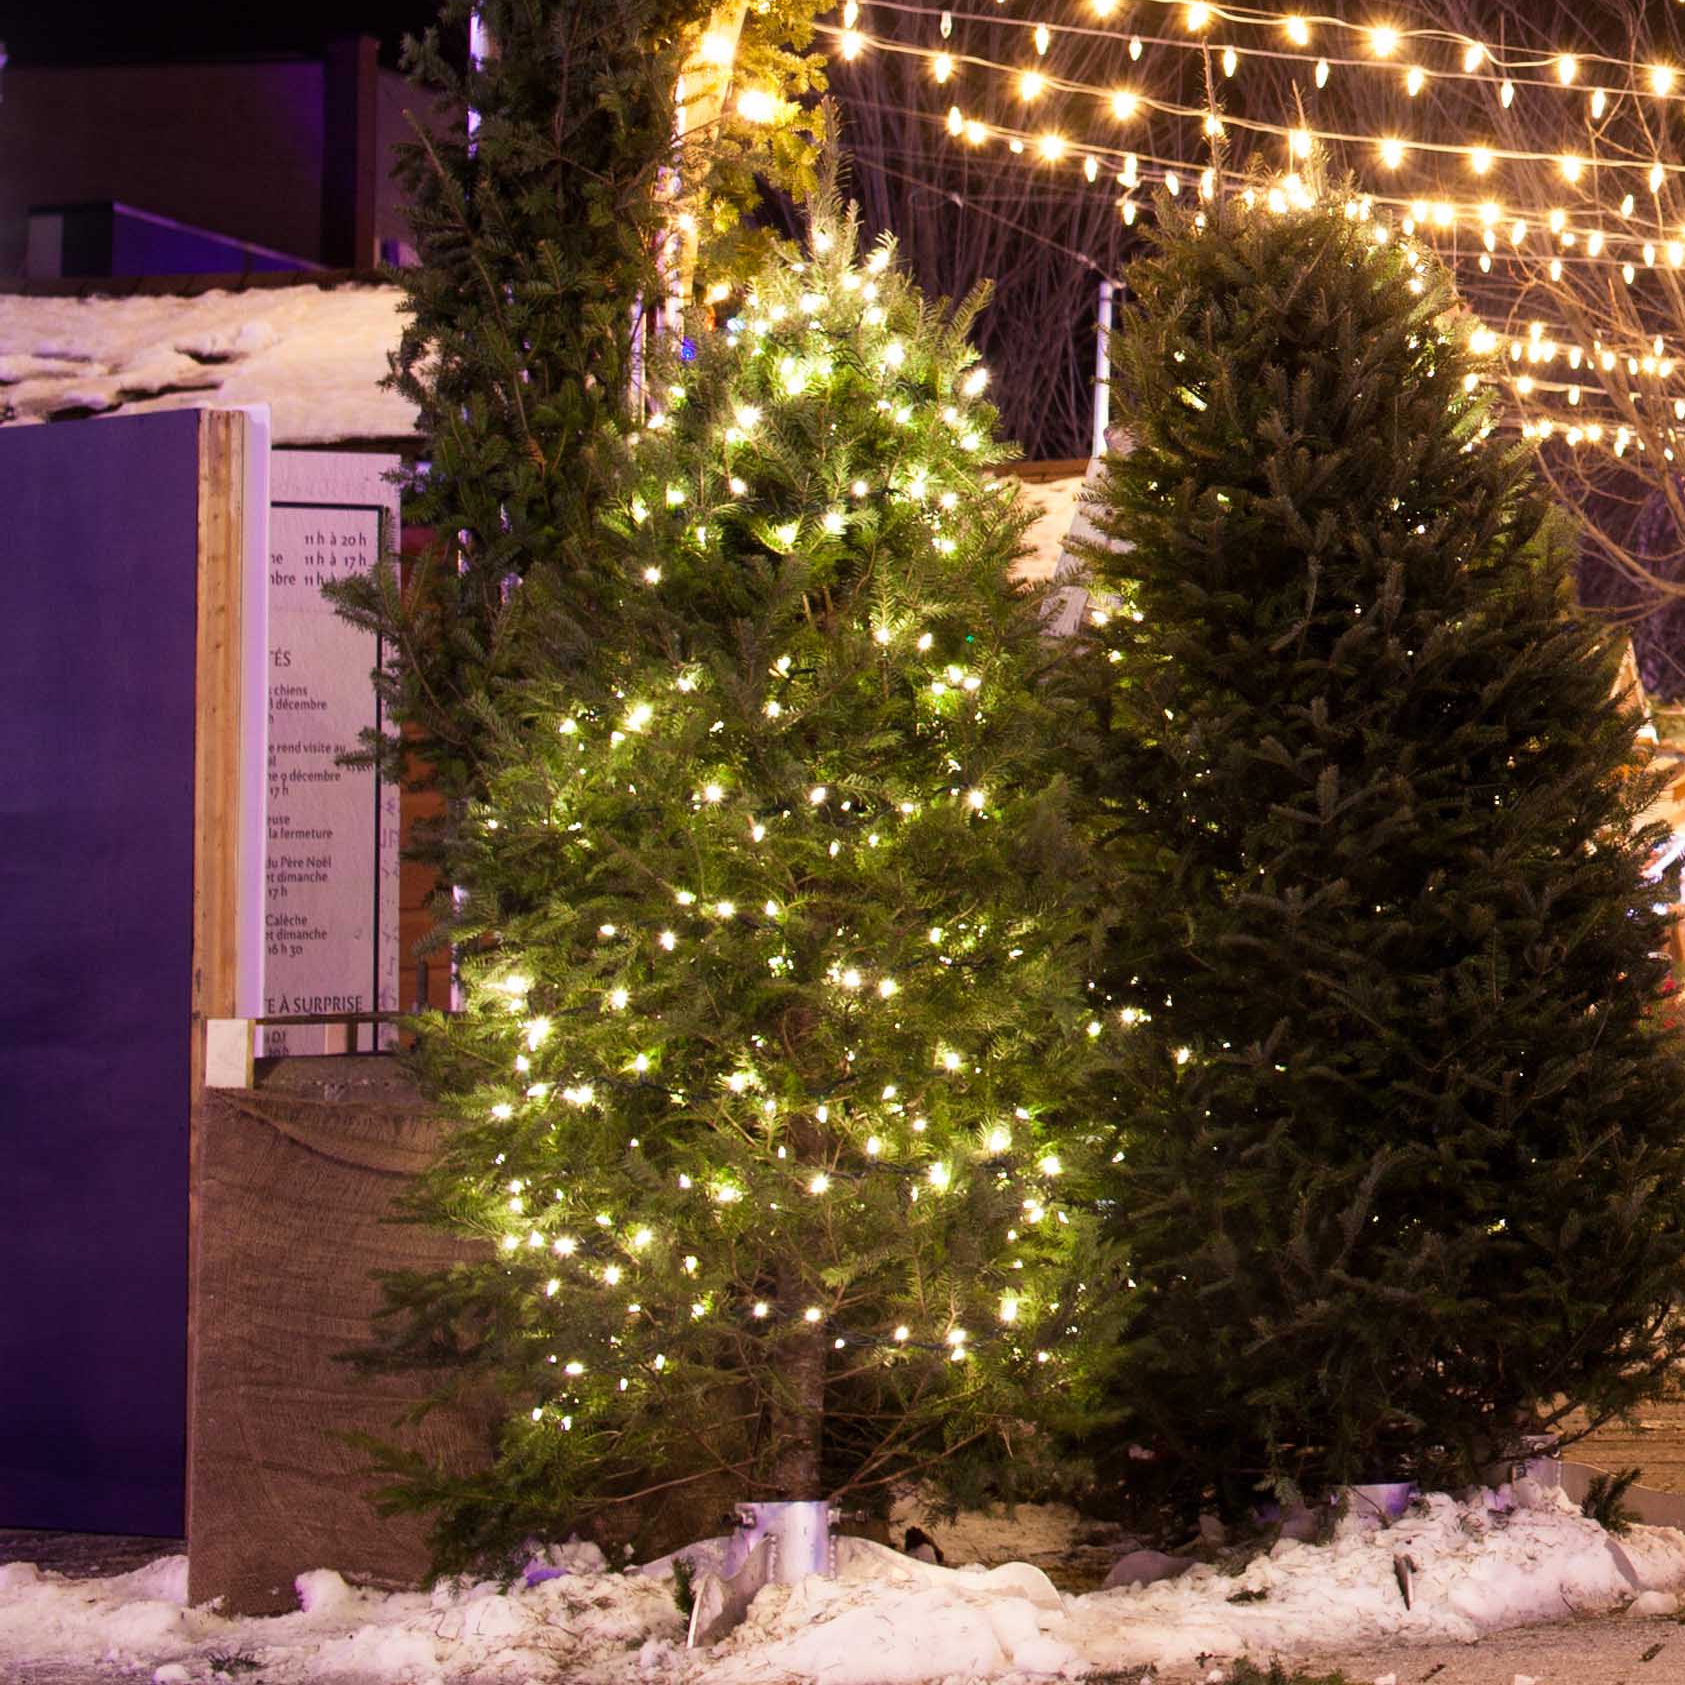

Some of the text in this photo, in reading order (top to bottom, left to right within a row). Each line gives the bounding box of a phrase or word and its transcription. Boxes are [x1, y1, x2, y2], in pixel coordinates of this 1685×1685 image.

[274, 684, 308, 696] chiens
[275, 697, 328, 711] décembre
[276, 740, 301, 754] rend
[303, 741, 332, 754] visite
[333, 743, 347, 754] au
[289, 768, 342, 782] décembre
[280, 827, 334, 839] fermeture
[280, 856, 305, 868] Père
[306, 855, 332, 868] Noël
[276, 870, 329, 883] dimanche
[265, 913, 308, 926] Calèche
[276, 927, 328, 941] dimanche
[278, 994, 290, 1013] À
[293, 995, 363, 1014] SURPRISE
